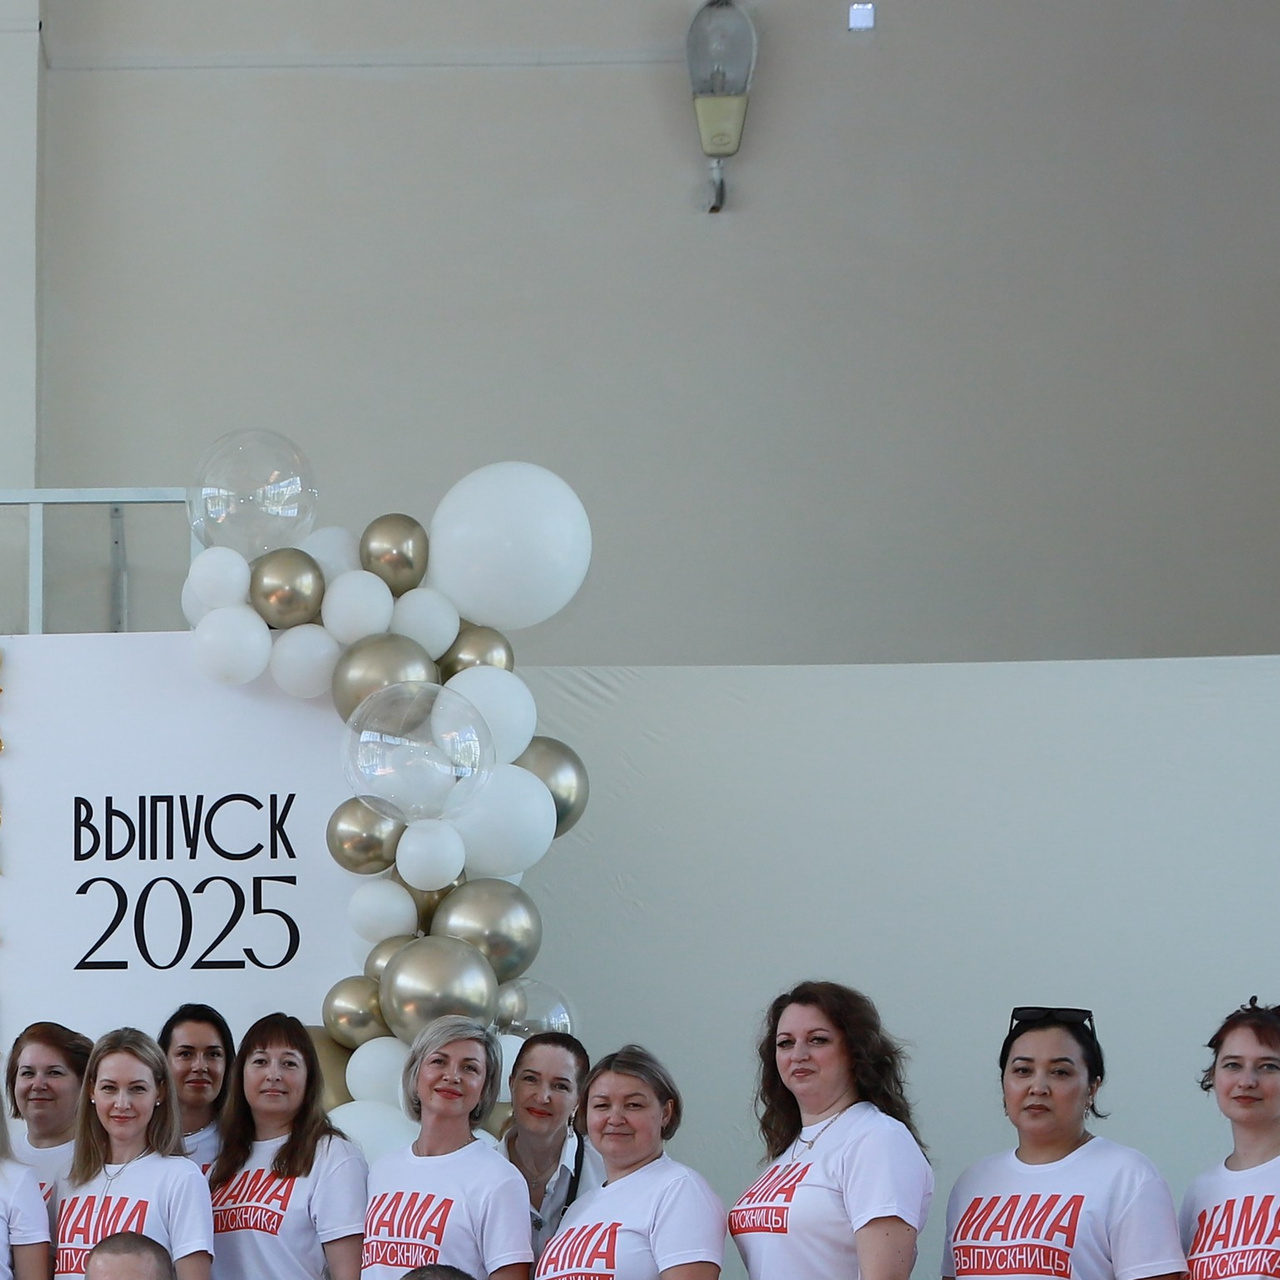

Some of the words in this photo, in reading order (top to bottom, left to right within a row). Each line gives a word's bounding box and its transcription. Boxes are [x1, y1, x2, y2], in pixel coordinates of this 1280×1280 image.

[73, 793, 297, 861] ВЫПУСК
[73, 875, 301, 970] 2025
[953, 1194, 1085, 1249] МАМА
[954, 1247, 1071, 1275] ВЫПУСКНИЦЫ
